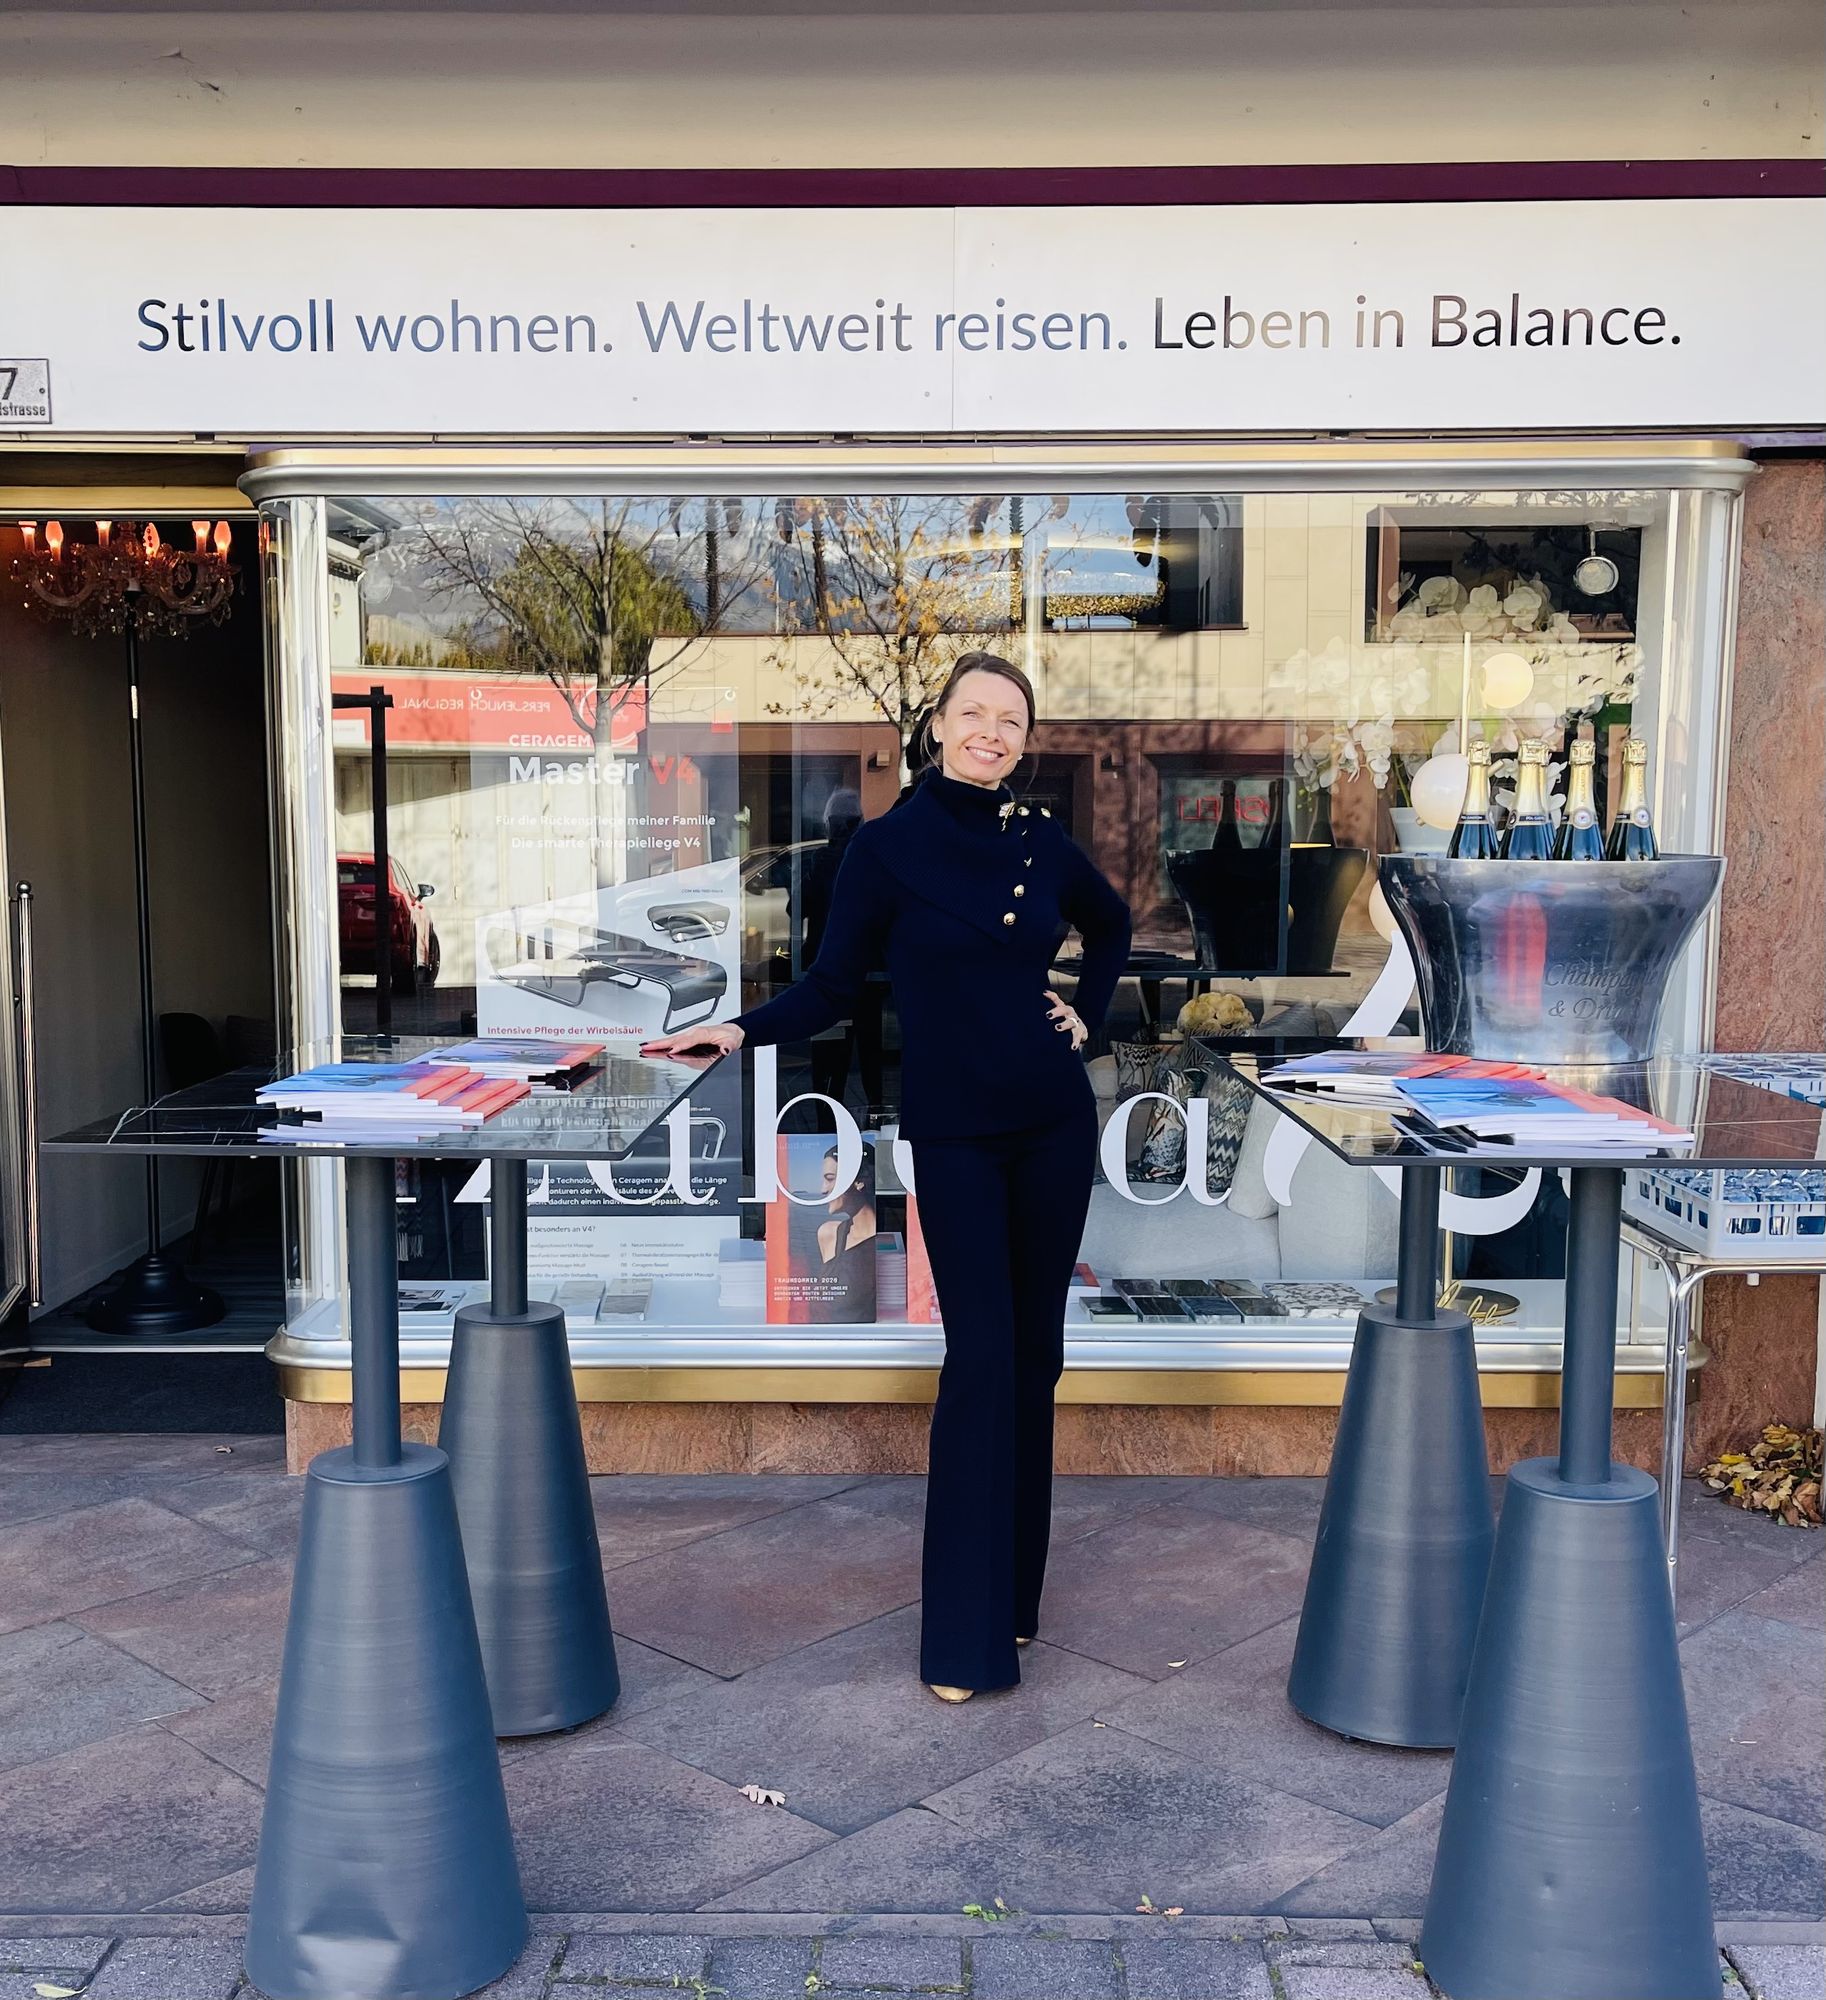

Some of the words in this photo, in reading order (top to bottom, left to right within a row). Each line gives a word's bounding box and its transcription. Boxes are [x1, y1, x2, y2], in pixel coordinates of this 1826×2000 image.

[136, 298, 334, 353] Stilvoll
[355, 298, 612, 353] wohnen.
[636, 298, 913, 353] Weltweit
[935, 297, 1128, 352] reisen.
[1154, 294, 1330, 350] Leben
[1354, 294, 1404, 349] in
[1431, 292, 1682, 348] Balance.
[0, 402, 46, 417] strasse
[508, 734, 593, 747] CERAGEM
[508, 756, 640, 785] Master
[649, 755, 697, 785] V4
[627, 816, 670, 826] meiner
[672, 815, 716, 826] Familie
[683, 838, 701, 849] V4
[487, 1026, 532, 1035] Intensive
[534, 1026, 566, 1037] Pflege
[568, 1026, 583, 1035] der
[586, 1026, 644, 1035] Wirbelsäule
[534, 1225, 571, 1233] besonders
